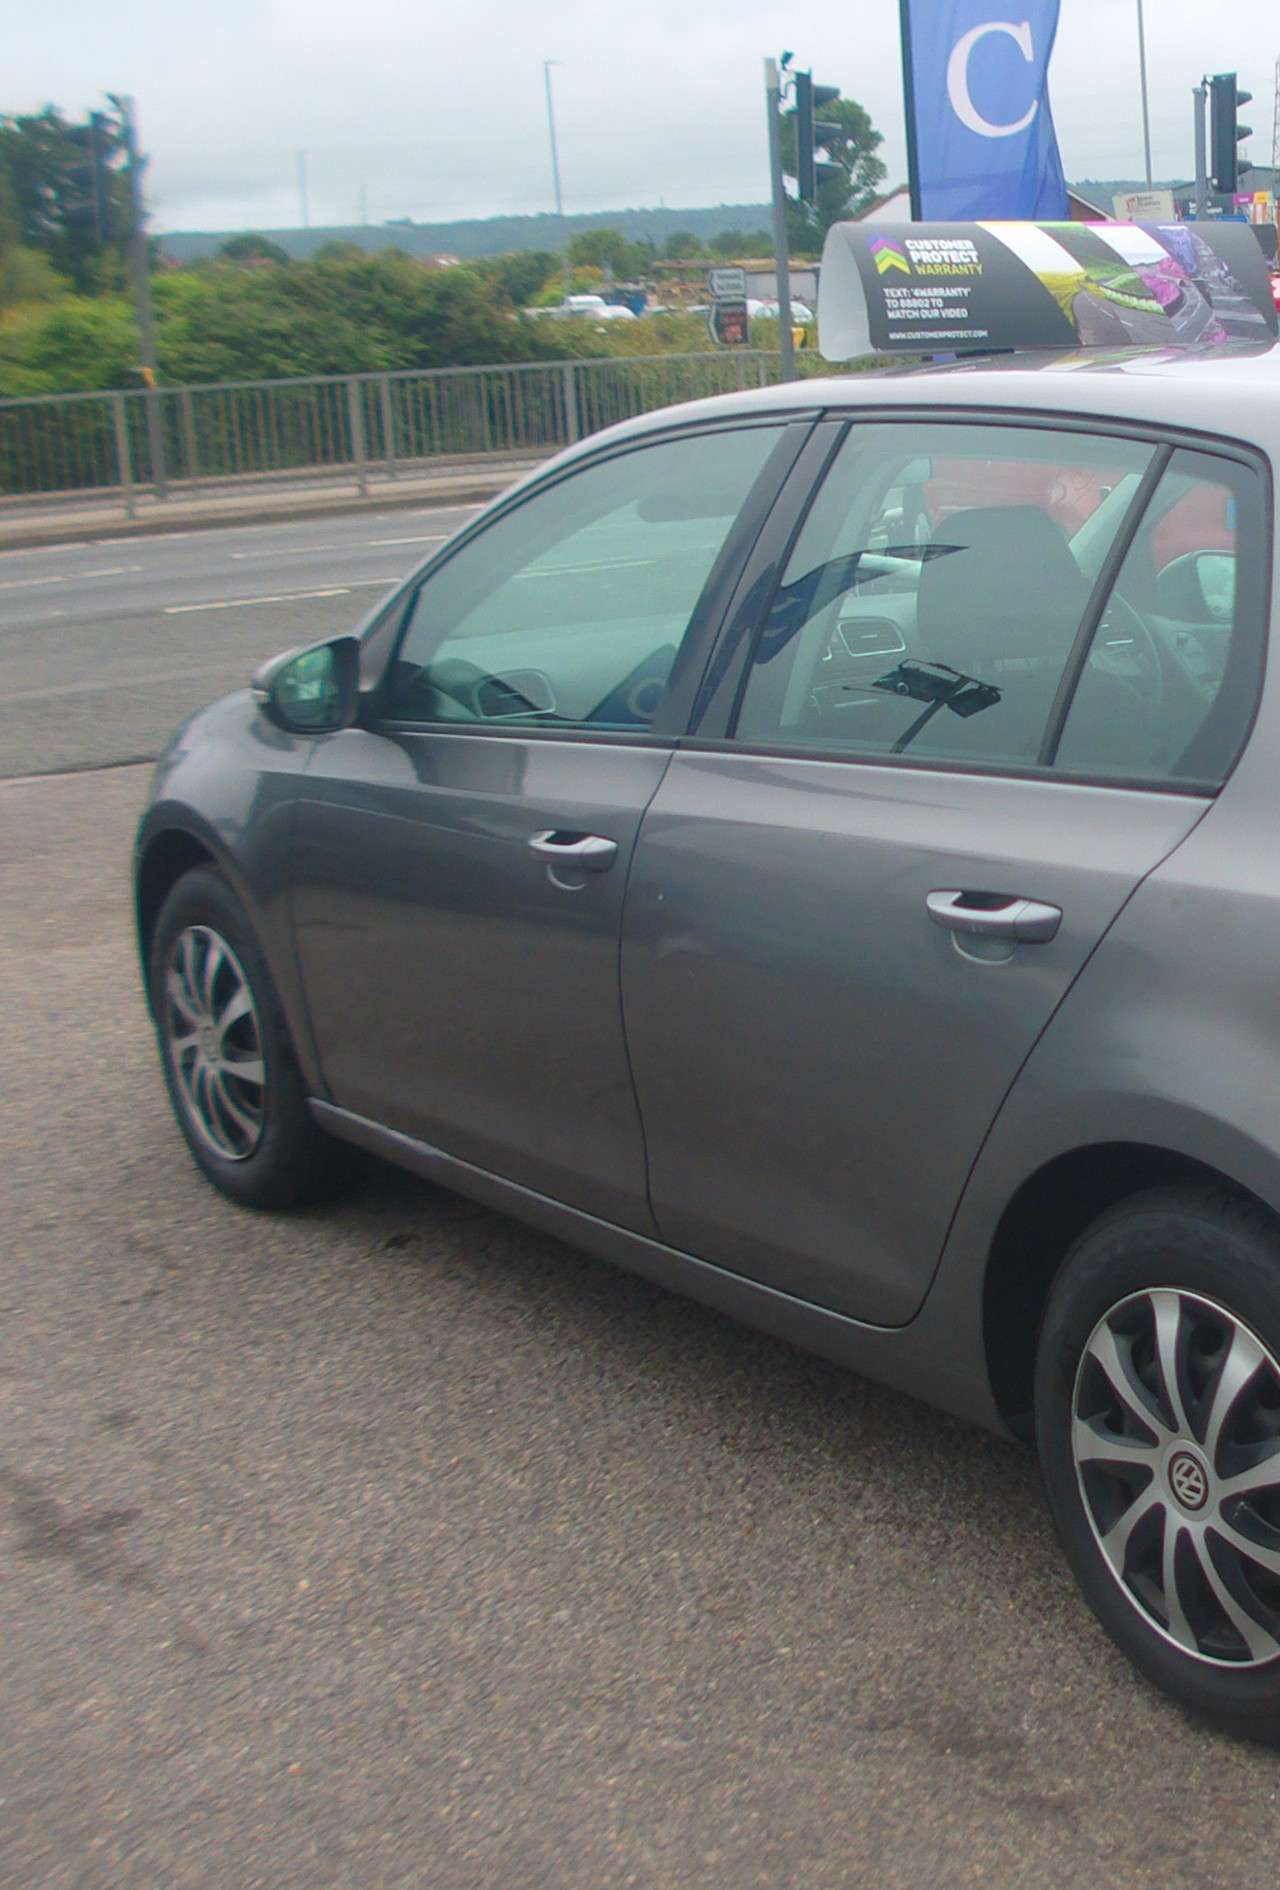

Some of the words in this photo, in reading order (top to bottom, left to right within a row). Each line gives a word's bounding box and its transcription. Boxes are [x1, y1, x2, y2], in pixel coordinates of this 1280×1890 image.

[946, 20, 1038, 137] C
[905, 239, 975, 250] CUSTOMER
[909, 250, 979, 263] PROTECT
[914, 263, 983, 275] WARRANTY
[885, 299, 899, 309] TO
[930, 298, 944, 308] TO
[886, 309, 920, 319] WATCH
[920, 308, 940, 318] OUR
[940, 308, 968, 318] VIDEO
